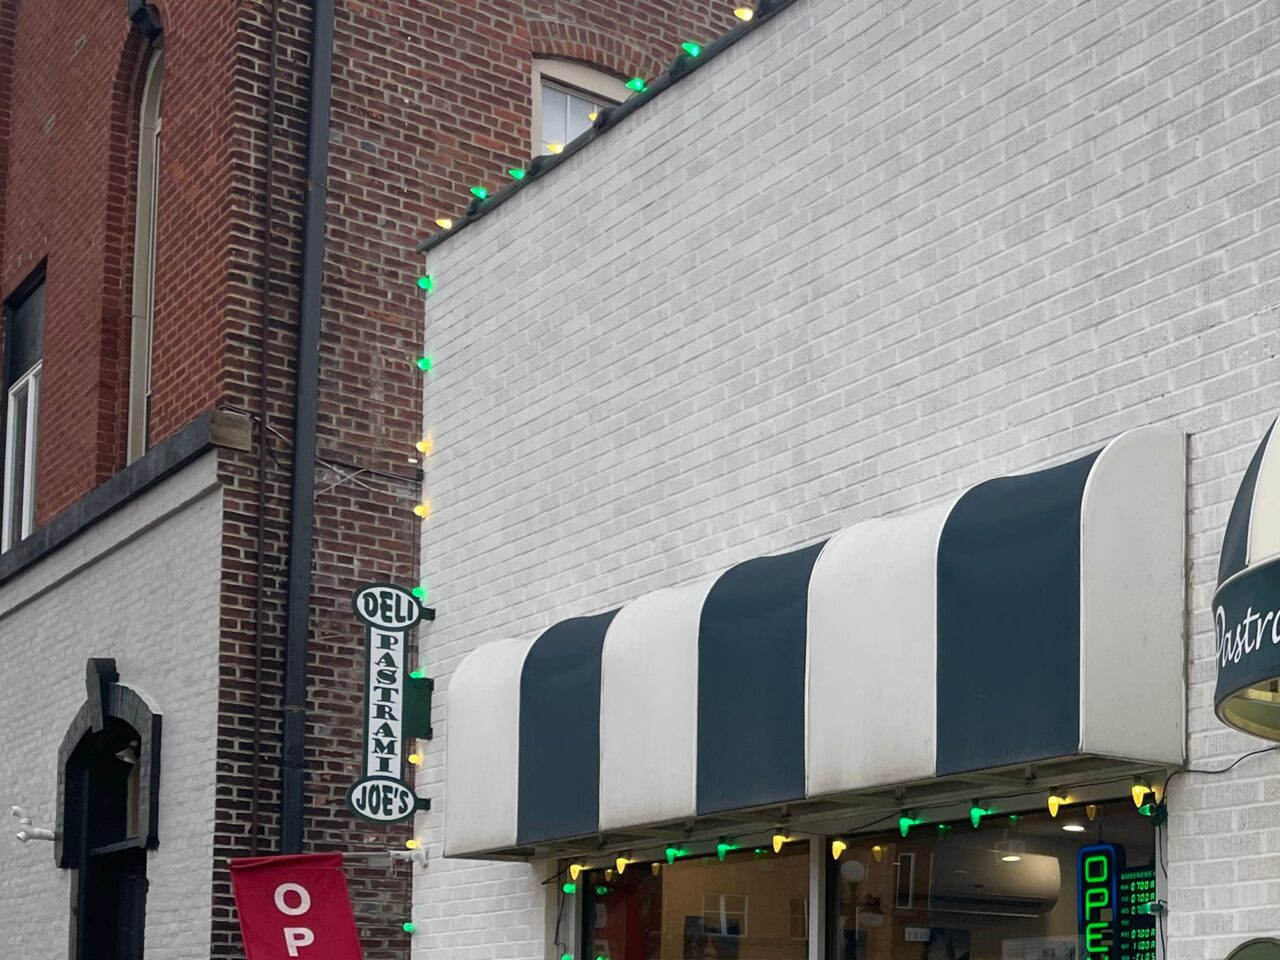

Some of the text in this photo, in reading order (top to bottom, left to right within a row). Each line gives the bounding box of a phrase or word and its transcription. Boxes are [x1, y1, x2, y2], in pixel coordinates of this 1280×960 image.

[362, 591, 414, 624] DELI
[371, 633, 400, 774] PASTRAMI
[355, 783, 409, 817] JOE'S
